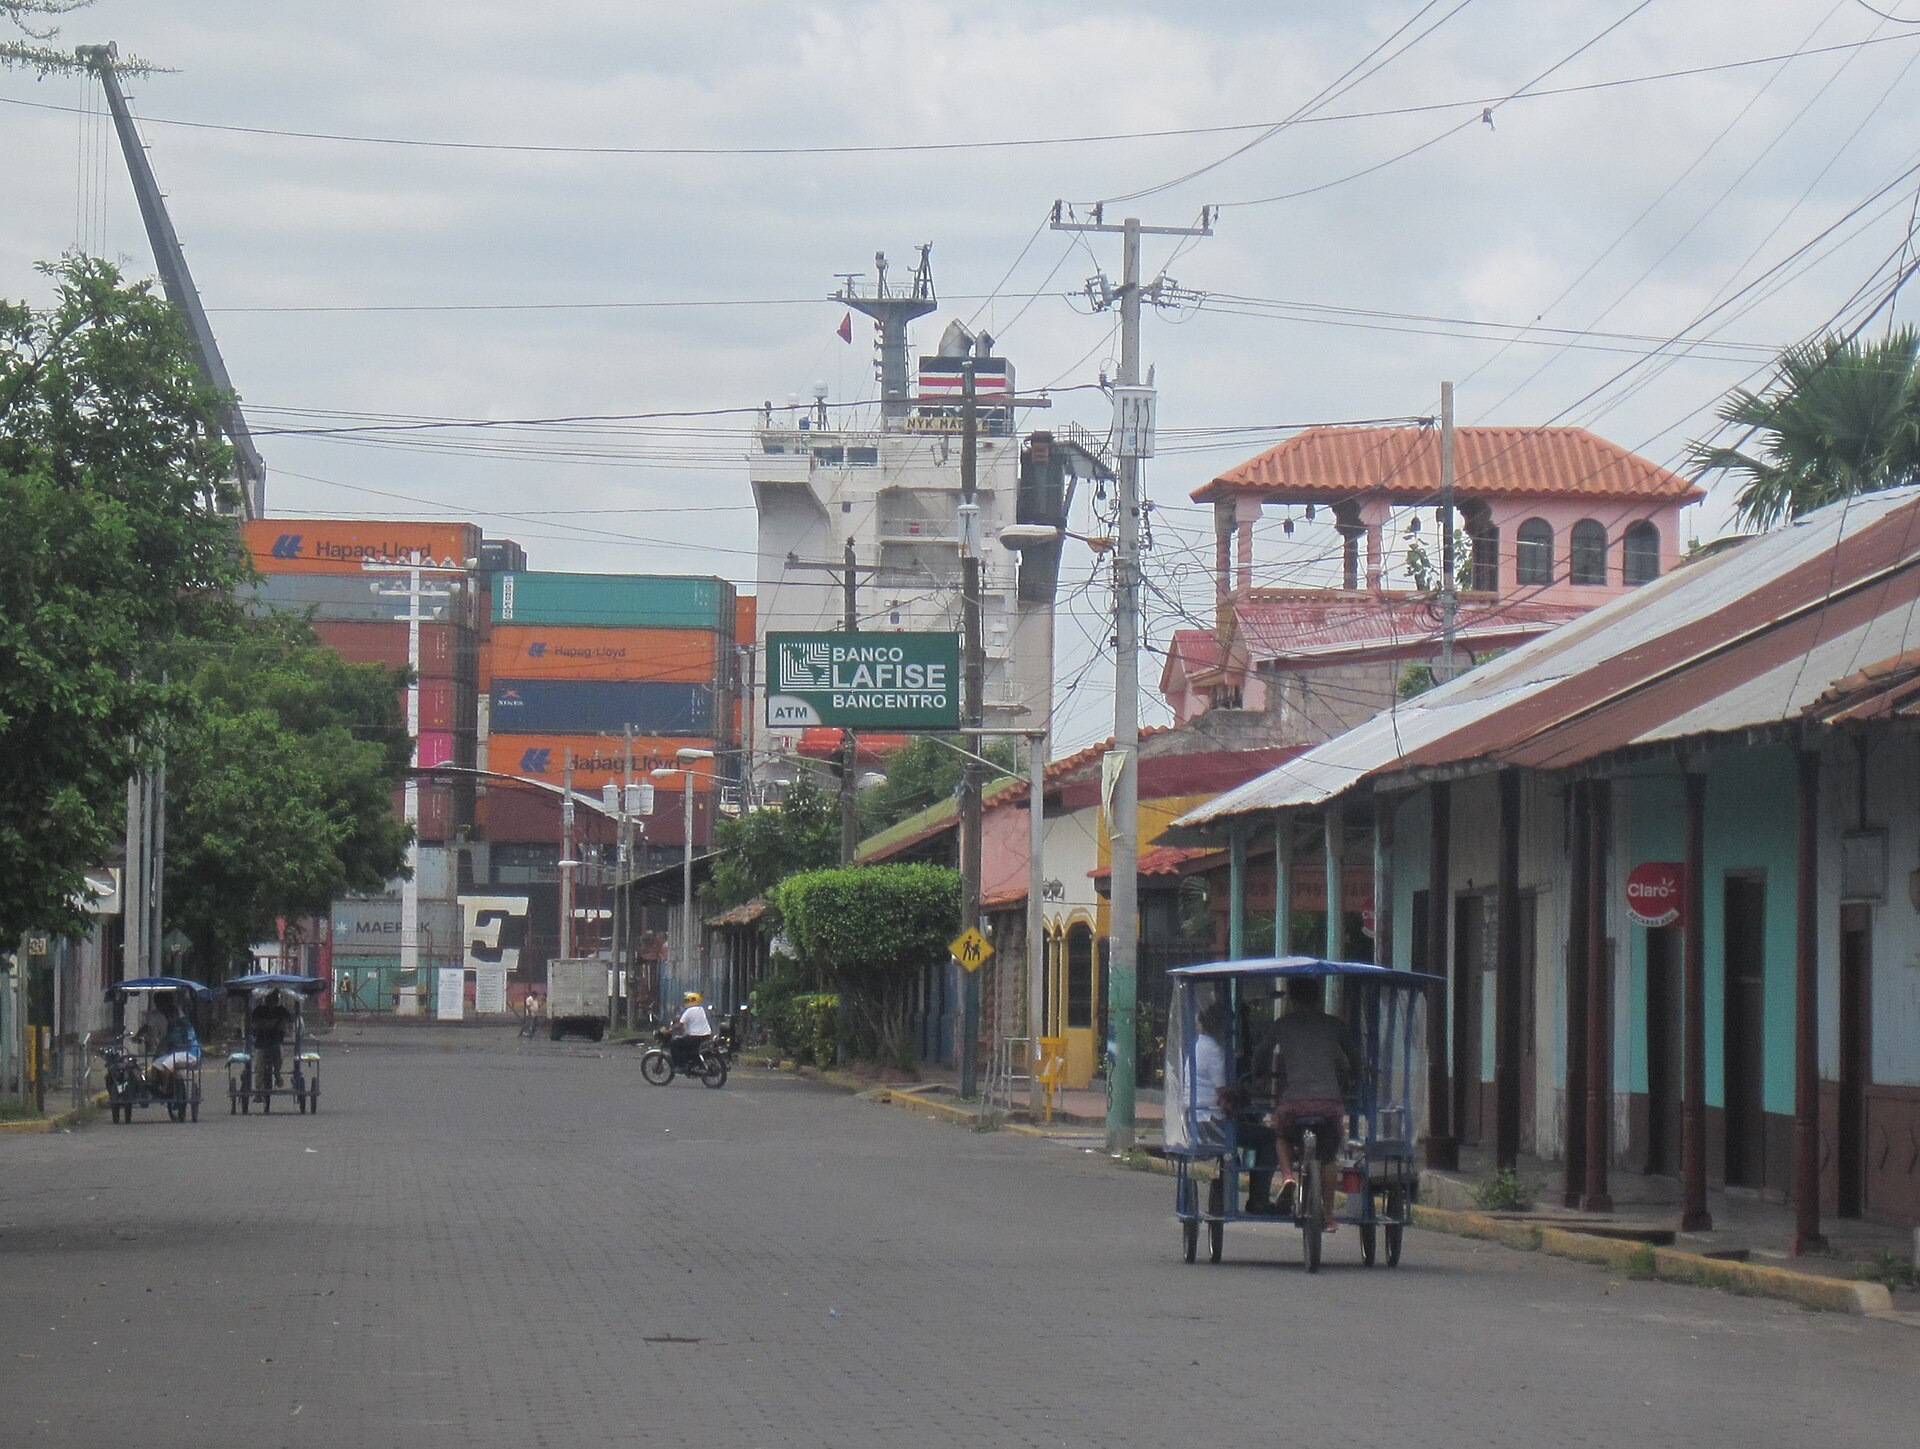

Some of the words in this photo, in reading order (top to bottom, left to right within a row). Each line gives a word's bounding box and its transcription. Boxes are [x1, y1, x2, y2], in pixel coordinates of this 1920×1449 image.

[907, 418, 933, 429] NYK
[554, 645, 626, 659] Hapag-Lloyd
[833, 647, 904, 662] BANCO
[833, 664, 946, 689] LAFISE
[833, 694, 946, 709] BANCENTRO
[775, 706, 808, 719] ATM
[571, 754, 680, 775] apagLloyd
[1627, 882, 1669, 898] Claro
[356, 921, 431, 934] MAERK
